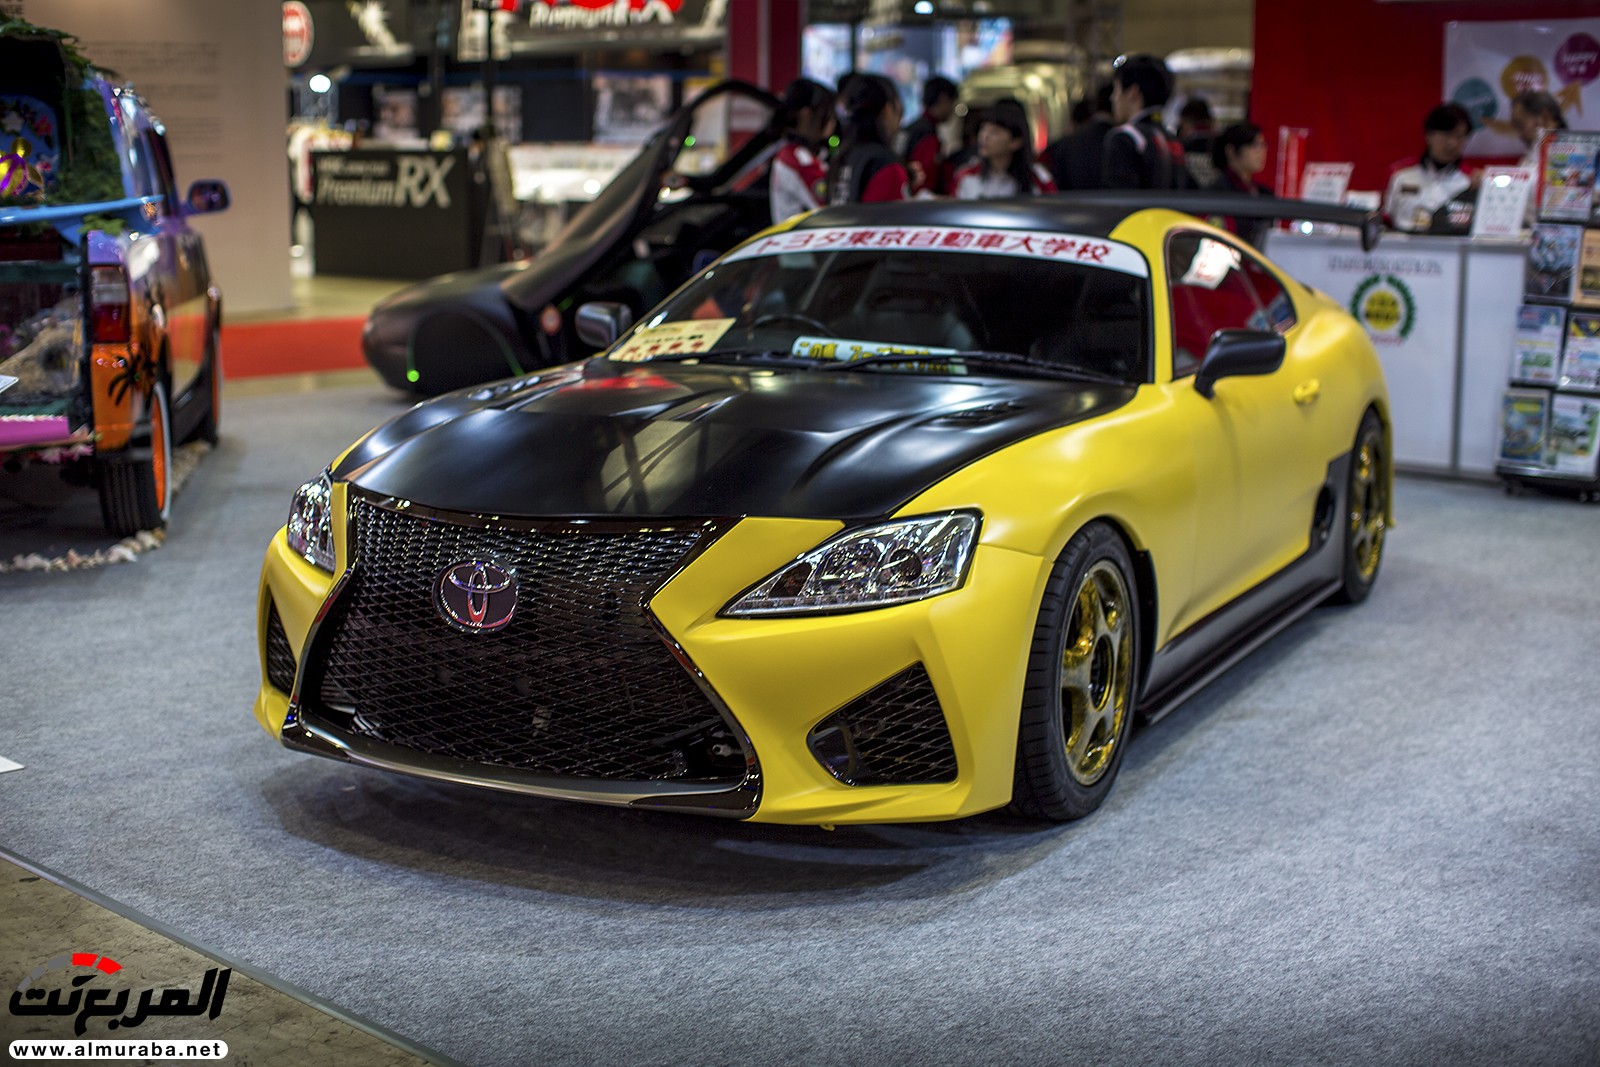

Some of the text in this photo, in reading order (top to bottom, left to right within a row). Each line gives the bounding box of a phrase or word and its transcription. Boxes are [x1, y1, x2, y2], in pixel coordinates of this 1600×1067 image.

[317, 176, 394, 206] Premium
[394, 154, 456, 208] RX
[755, 228, 1111, 263] トヨタ東京自動車大学校
